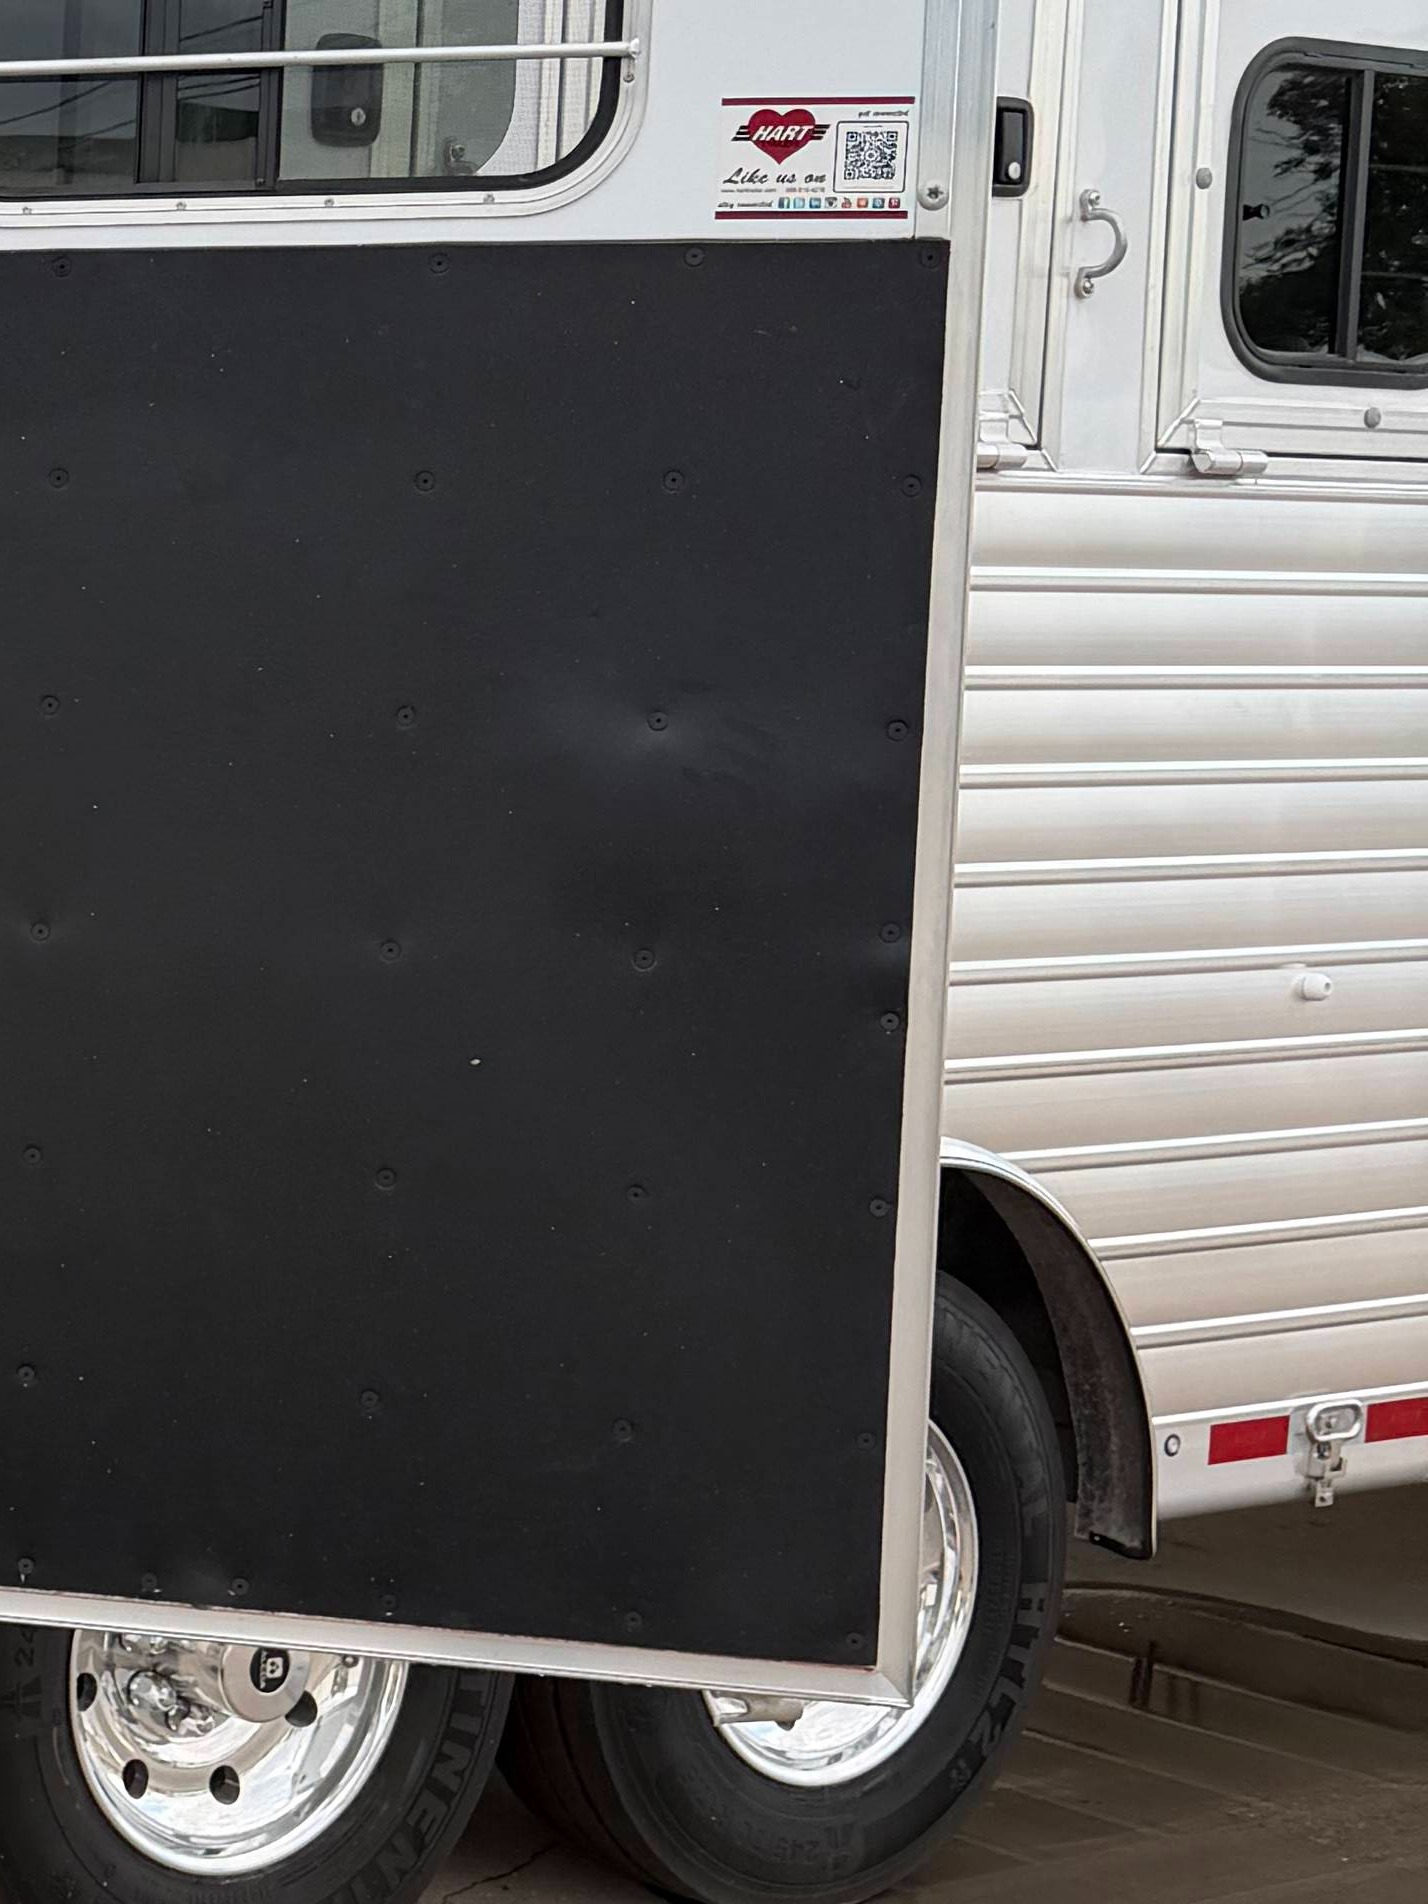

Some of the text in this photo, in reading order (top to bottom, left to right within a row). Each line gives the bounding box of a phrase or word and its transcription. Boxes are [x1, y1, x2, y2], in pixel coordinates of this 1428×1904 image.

[752, 125, 815, 141] HART
[722, 167, 827, 184] Like us on
